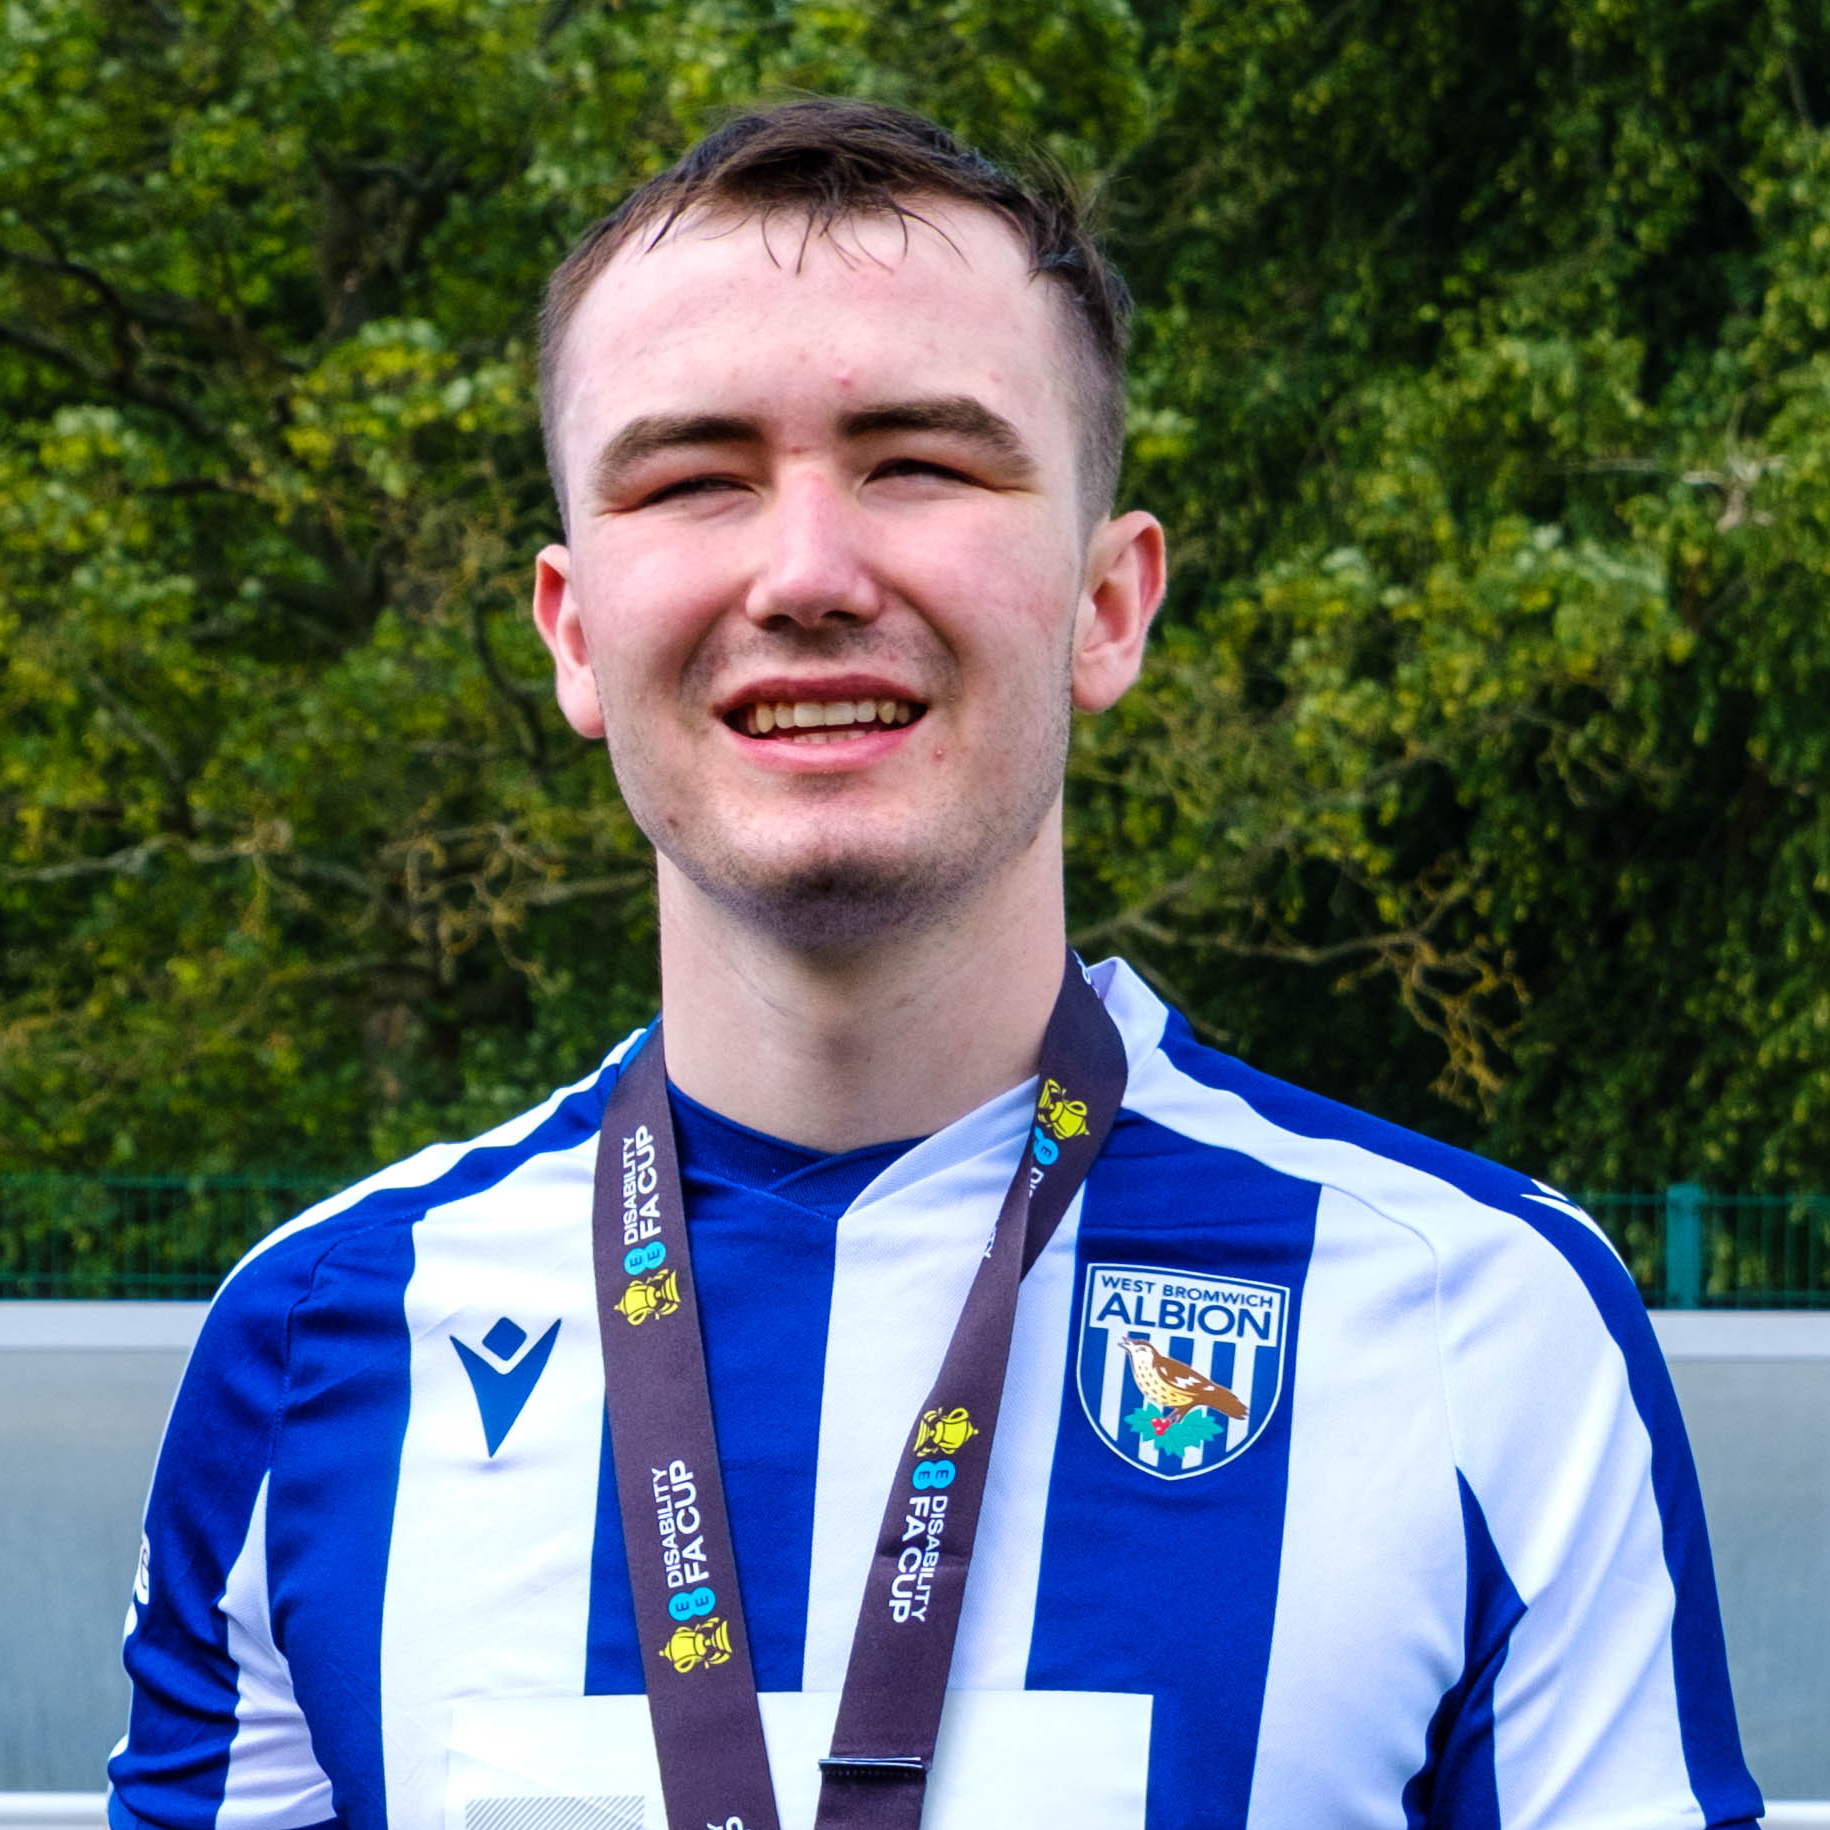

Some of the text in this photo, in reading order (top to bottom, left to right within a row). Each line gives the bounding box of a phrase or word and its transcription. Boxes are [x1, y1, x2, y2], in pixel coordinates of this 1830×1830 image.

[623, 1137, 638, 1245] DISABILITY
[636, 1124, 661, 1241] FA CUP
[1097, 1292, 1271, 1340] ALBION
[1101, 1275, 1273, 1308] WEST BROMWICH
[651, 1467, 684, 1588] DISABILITY
[669, 1460, 709, 1584] FA CUP
[889, 1496, 930, 1623] FA CUP
[911, 1495, 948, 1622] DISABILITY
